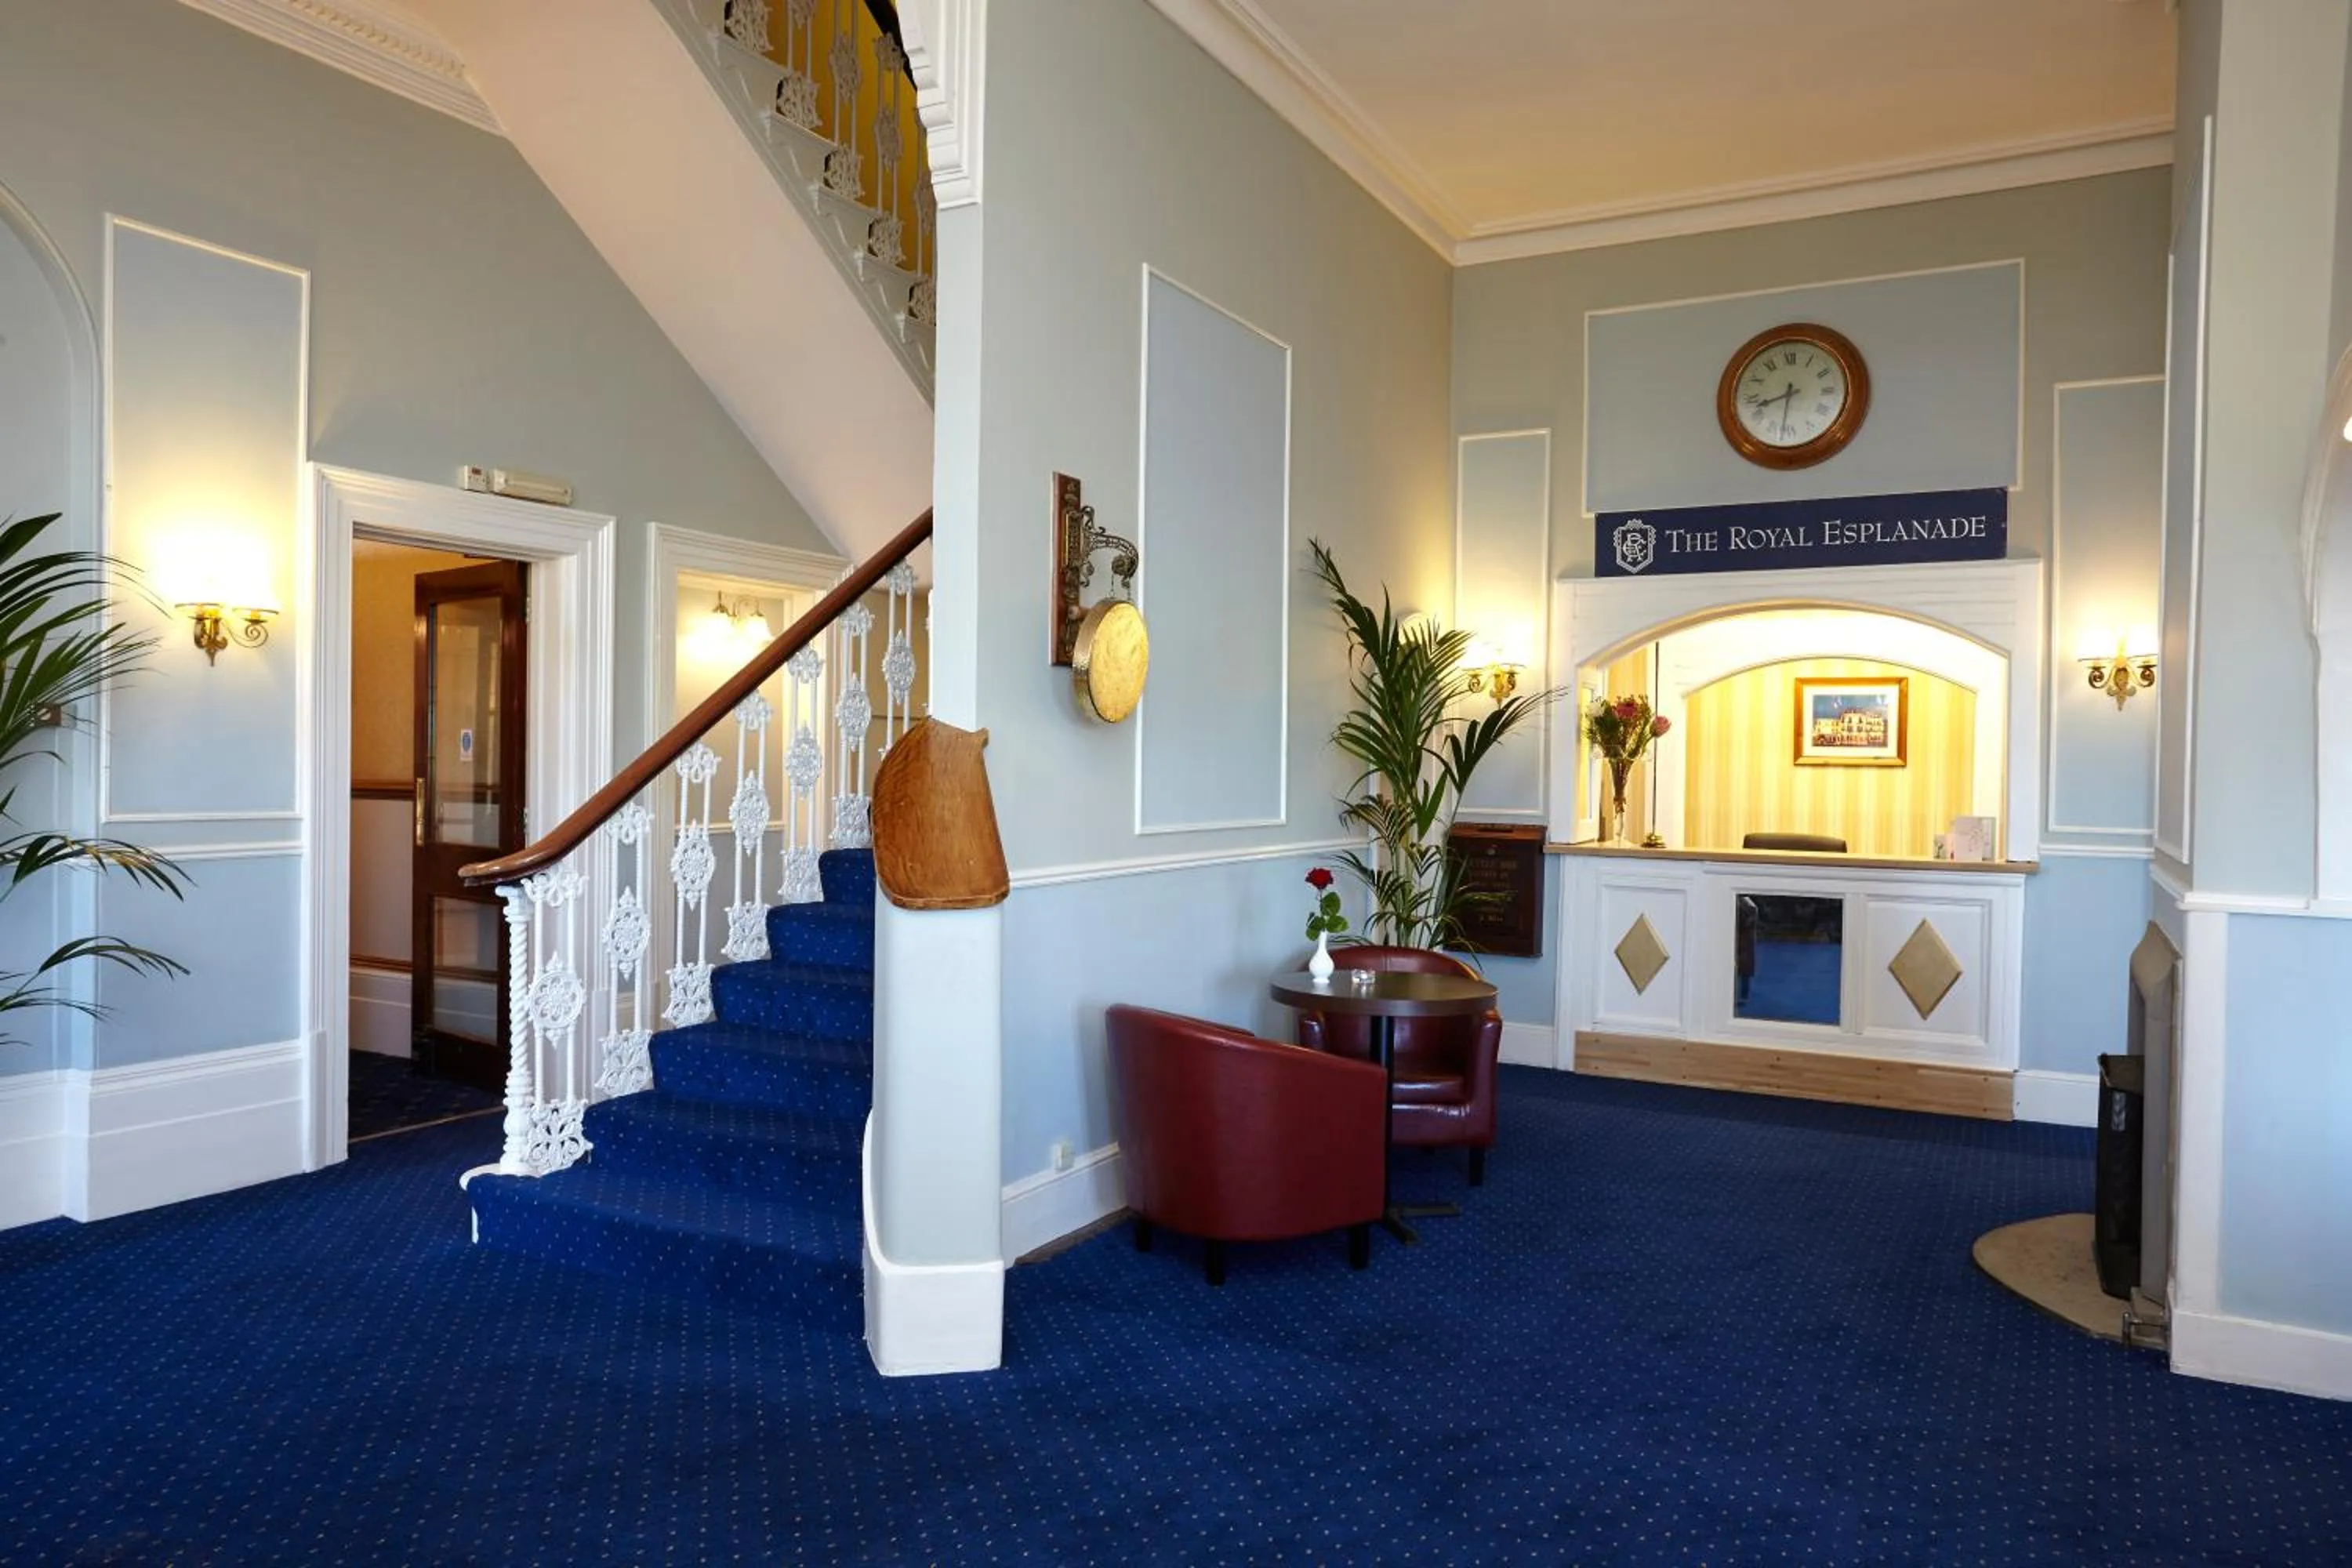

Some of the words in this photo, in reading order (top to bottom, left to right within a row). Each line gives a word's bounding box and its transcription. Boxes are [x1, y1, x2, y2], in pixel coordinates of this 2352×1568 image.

[1665, 528, 1718, 553] THE
[1730, 526, 1813, 550] ROYAL
[1823, 515, 1987, 546] ESPLANADE
